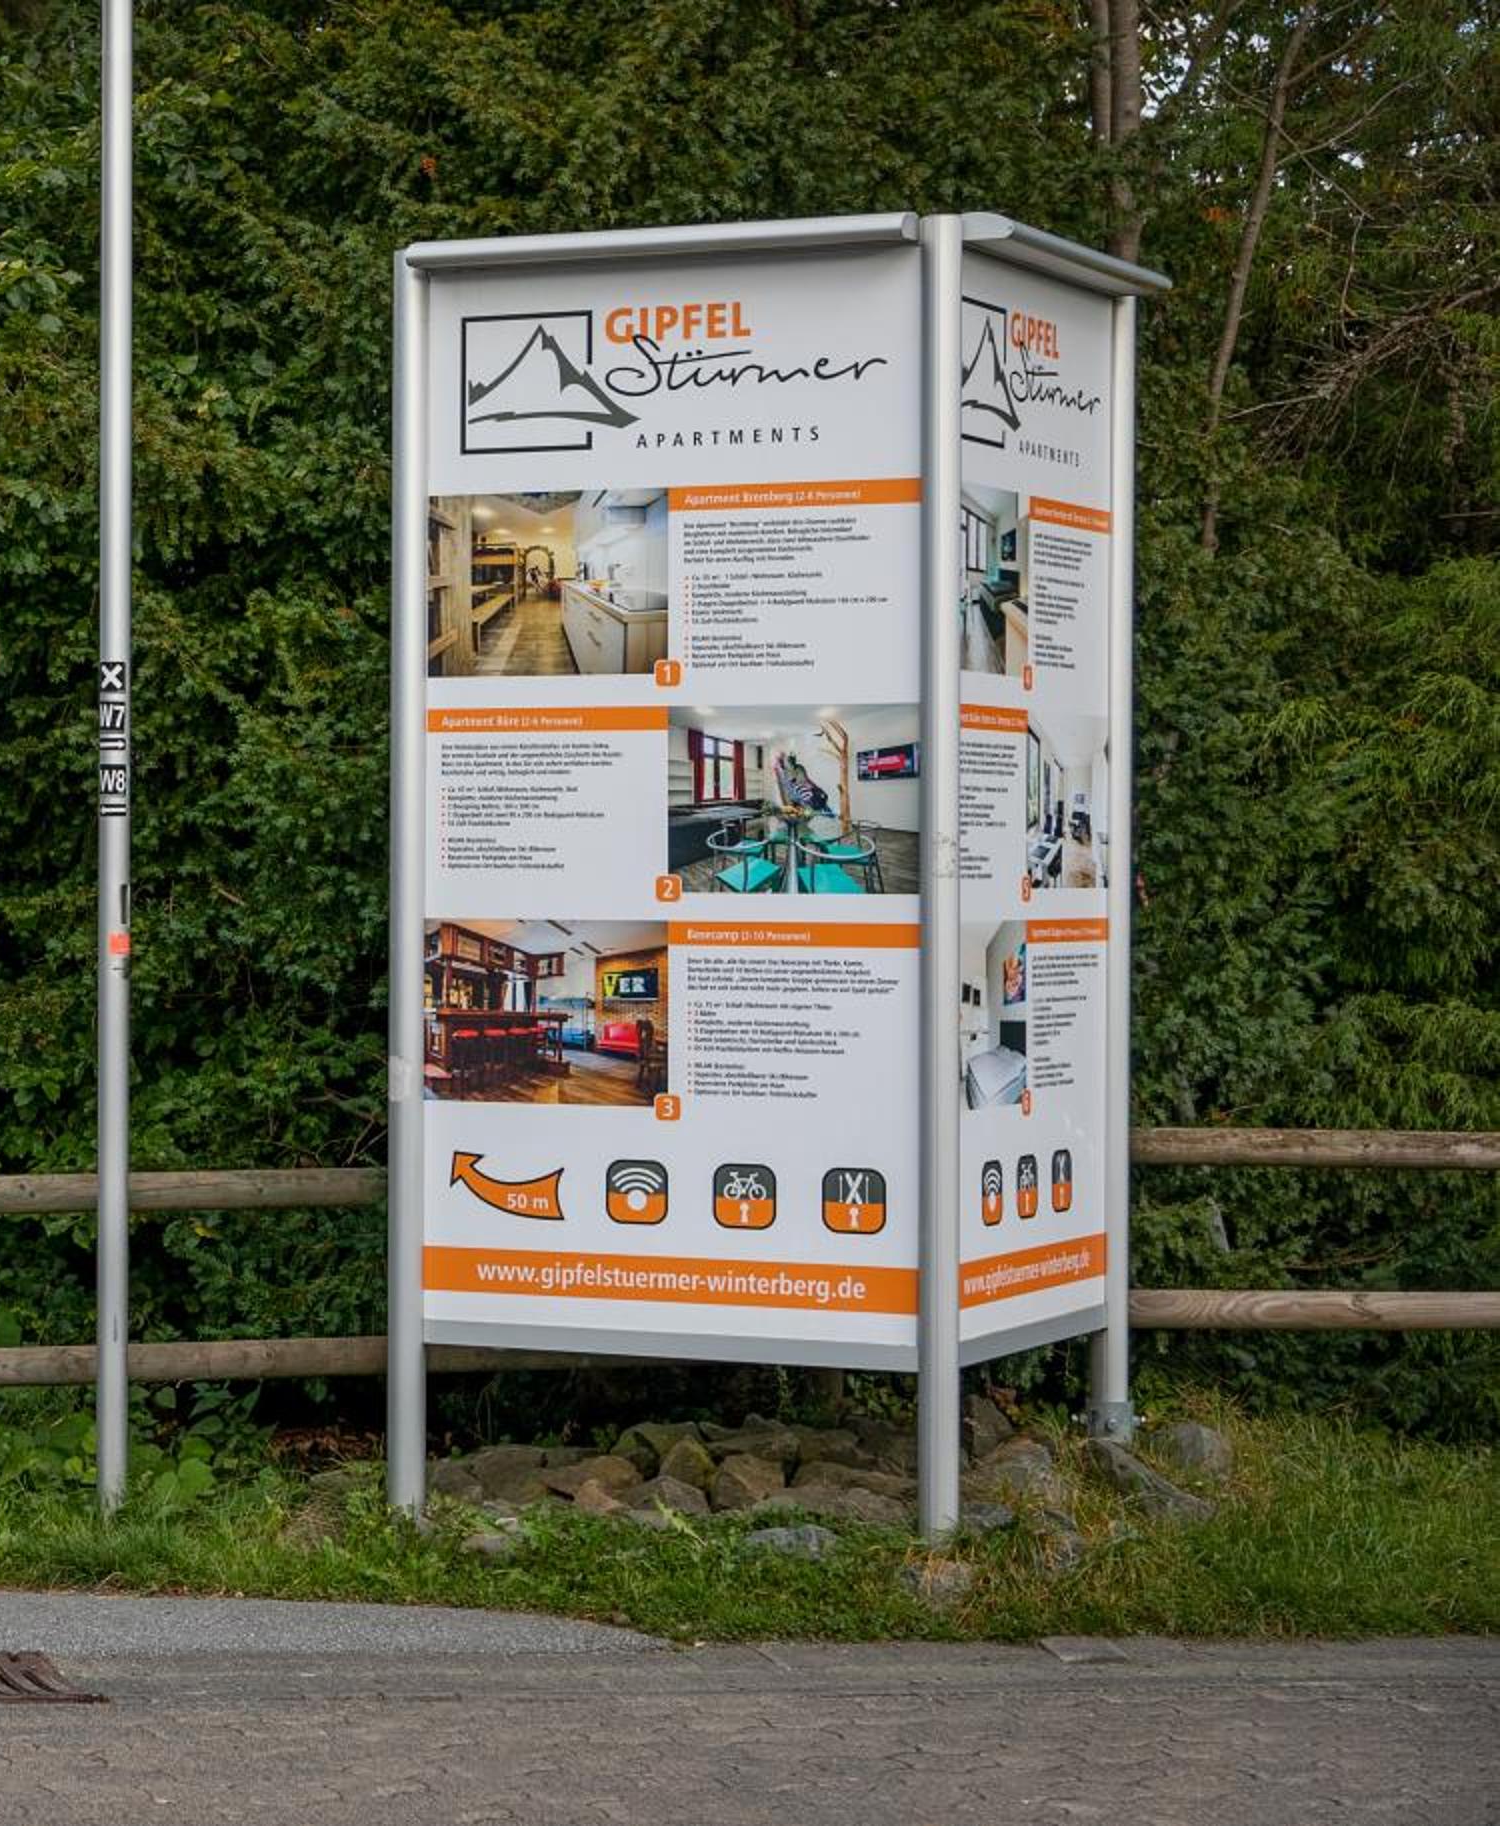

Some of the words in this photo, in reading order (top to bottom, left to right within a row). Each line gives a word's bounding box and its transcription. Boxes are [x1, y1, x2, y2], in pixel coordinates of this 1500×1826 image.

[605, 302, 751, 344] GIPFEL
[1011, 312, 1060, 360] GIPFEL
[604, 334, 887, 396] Stürmer
[1010, 342, 1101, 415] Stürmer
[636, 427, 819, 449] APARTMENTS
[663, 664, 671, 683] 1
[100, 704, 125, 728] W7
[100, 769, 125, 793] W8
[663, 879, 674, 899] 2
[662, 1098, 674, 1117] 3
[507, 1192, 527, 1210] 50
[533, 1197, 549, 1210] m
[476, 1261, 866, 1304] www.gipfelstuermer-winterberg.de
